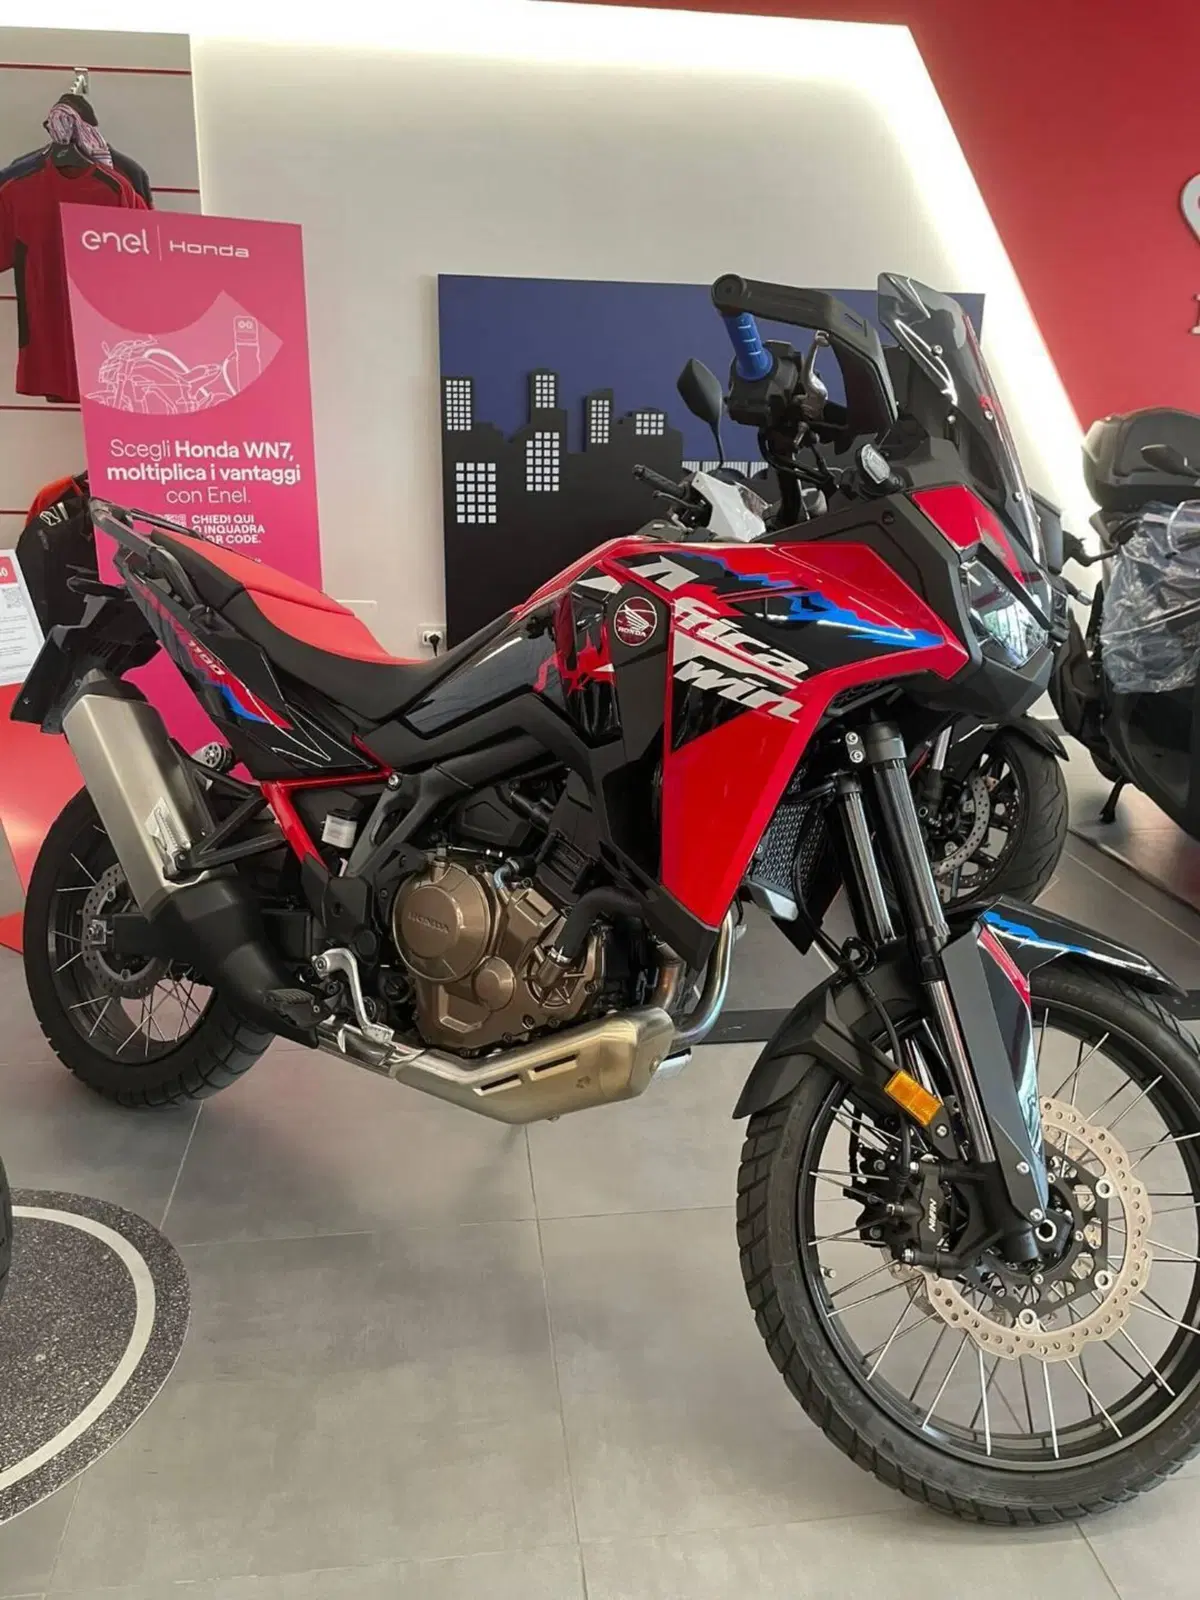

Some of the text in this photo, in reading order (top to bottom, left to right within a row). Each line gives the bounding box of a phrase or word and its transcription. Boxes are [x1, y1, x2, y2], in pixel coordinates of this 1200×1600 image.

[81, 229, 250, 259] enel Honda
[110, 438, 294, 462] Scegli Honda WN7,
[106, 462, 301, 485] moltiplica i vantaggi
[166, 486, 252, 504] con Enel.
[191, 514, 255, 525] CHIEDI QUI
[204, 524, 266, 535] INQUADRA
[617, 626, 647, 638] HONDA
